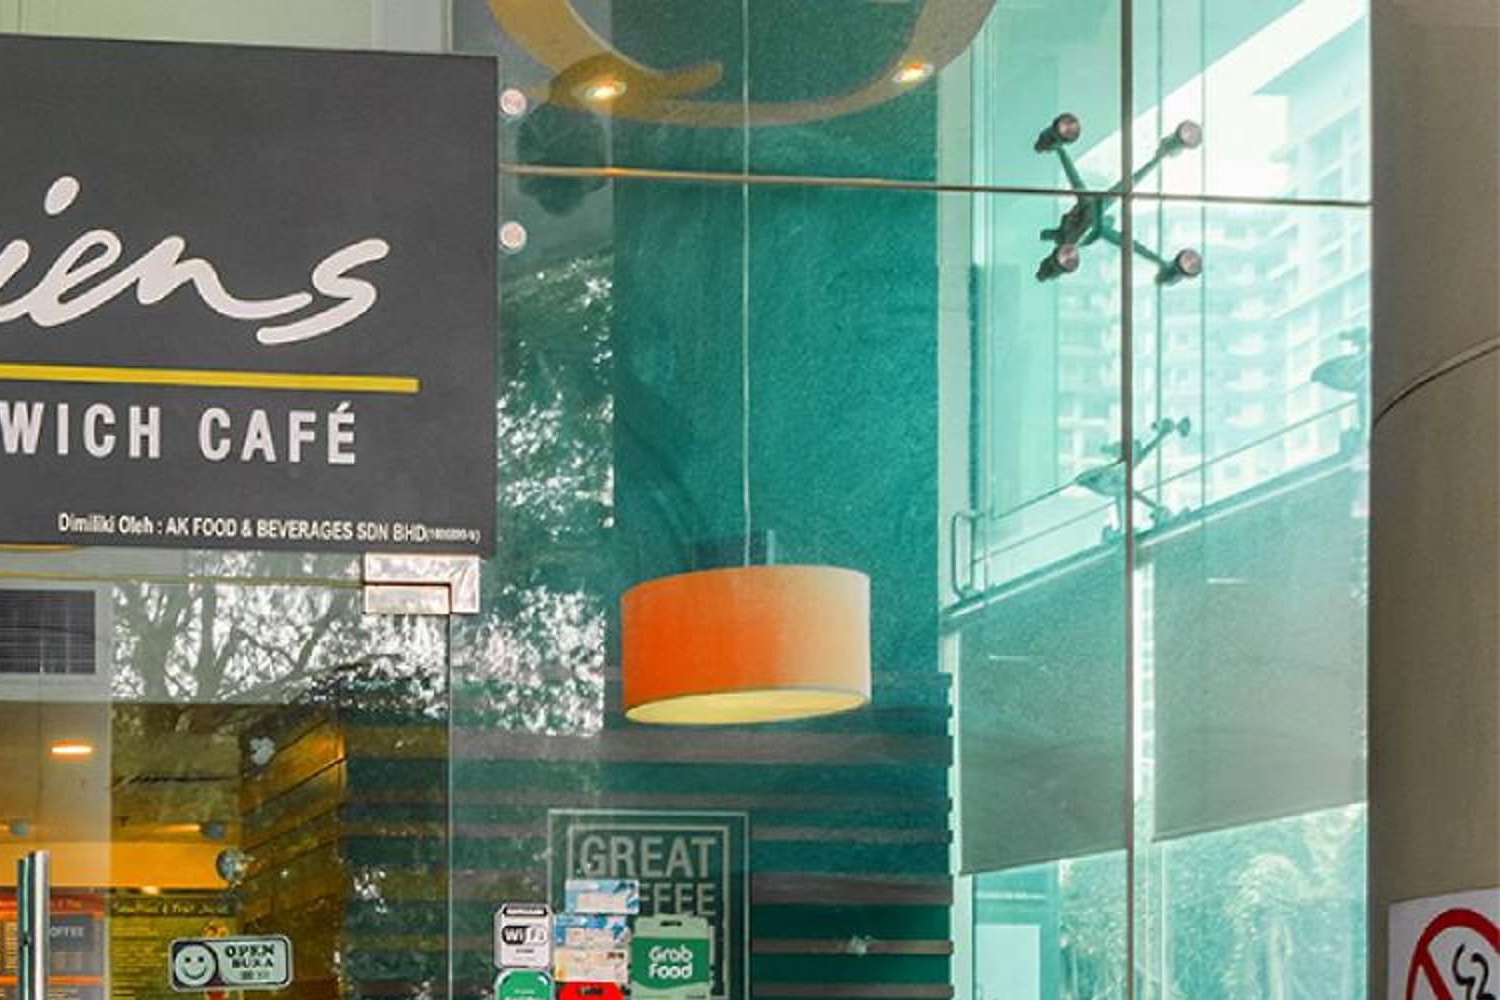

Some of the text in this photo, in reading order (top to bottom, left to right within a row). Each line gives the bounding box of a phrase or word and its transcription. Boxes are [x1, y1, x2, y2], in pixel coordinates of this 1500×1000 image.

[198, 402, 359, 467] CAFÉ
[58, 512, 116, 534] Dimiliki
[166, 517, 189, 536] AK
[193, 518, 237, 537] FOOD
[241, 519, 252, 538] &
[257, 519, 353, 540] BEVERAGES
[356, 522, 389, 541] SDN
[579, 835, 715, 878] GREAT
[225, 945, 275, 958] OPEN
[649, 945, 693, 963] Grab
[649, 963, 693, 979] Food
